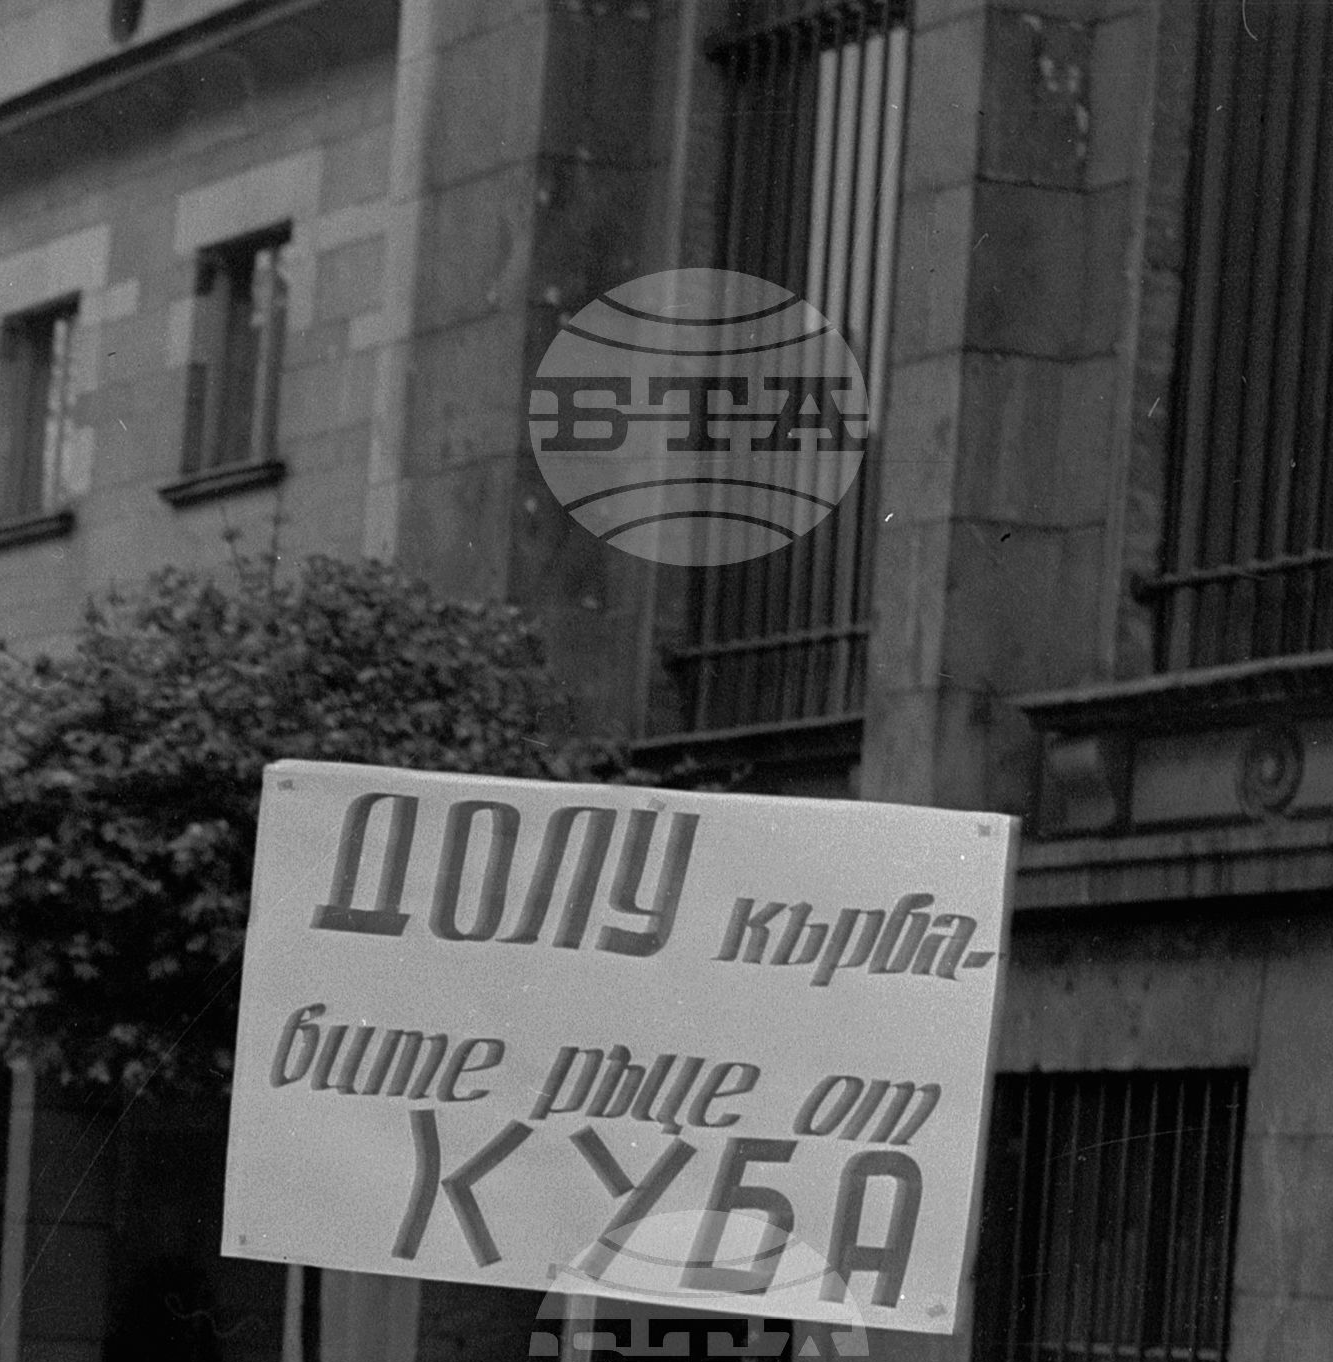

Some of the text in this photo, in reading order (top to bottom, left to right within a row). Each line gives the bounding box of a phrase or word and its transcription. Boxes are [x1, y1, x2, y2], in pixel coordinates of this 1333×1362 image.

[309, 791, 702, 958] ДОЛУ
[530, 1043, 762, 1136] ръце
[793, 1074, 942, 1146] от
[391, 1108, 925, 1309] КУБА
